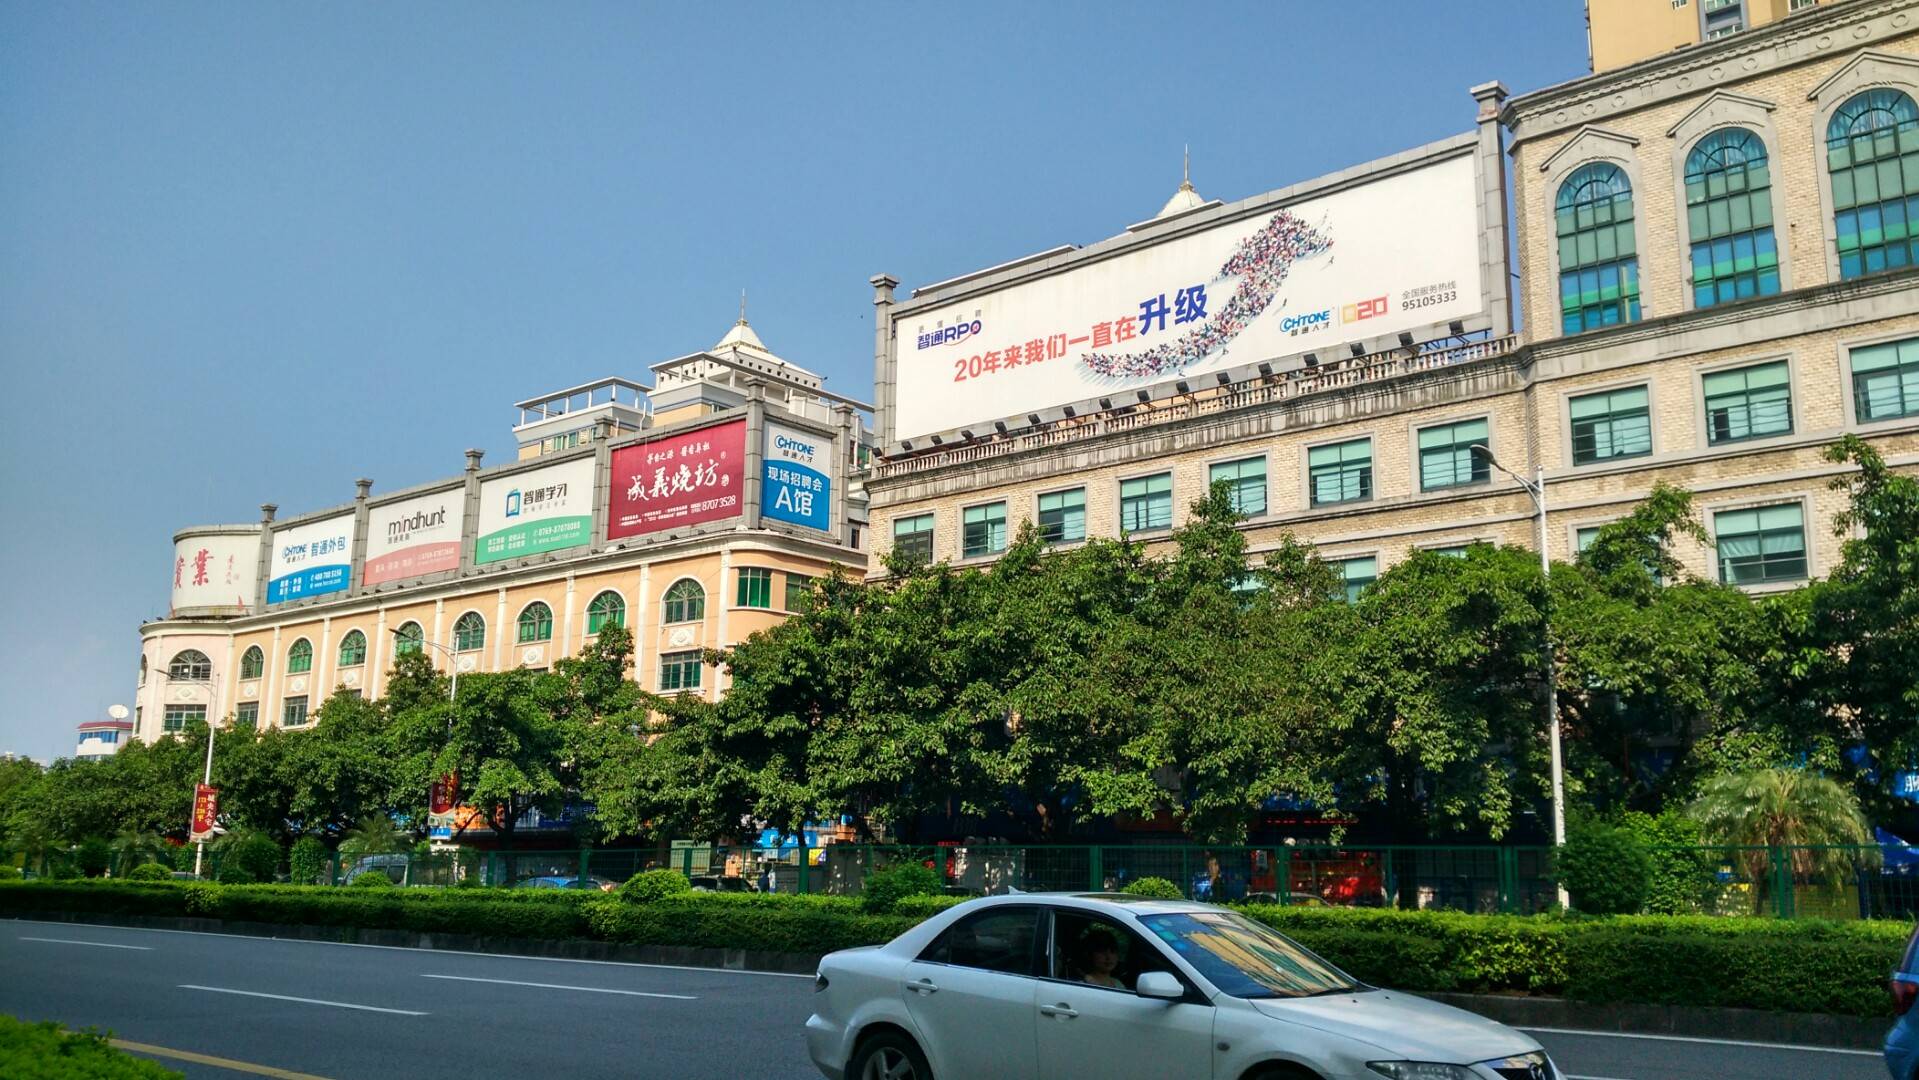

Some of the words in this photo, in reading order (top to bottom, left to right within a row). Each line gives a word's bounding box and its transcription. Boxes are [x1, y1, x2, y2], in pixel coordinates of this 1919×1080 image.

[1402, 280, 1456, 300] 全国服务热线
[1402, 290, 1457, 311] 95105333
[768, 466, 823, 492] 现场招聘会
[523, 483, 567, 505] 智通学习
[775, 485, 814, 517] A馆
[388, 505, 446, 536] mindhunt
[311, 536, 346, 557] 智通外包
